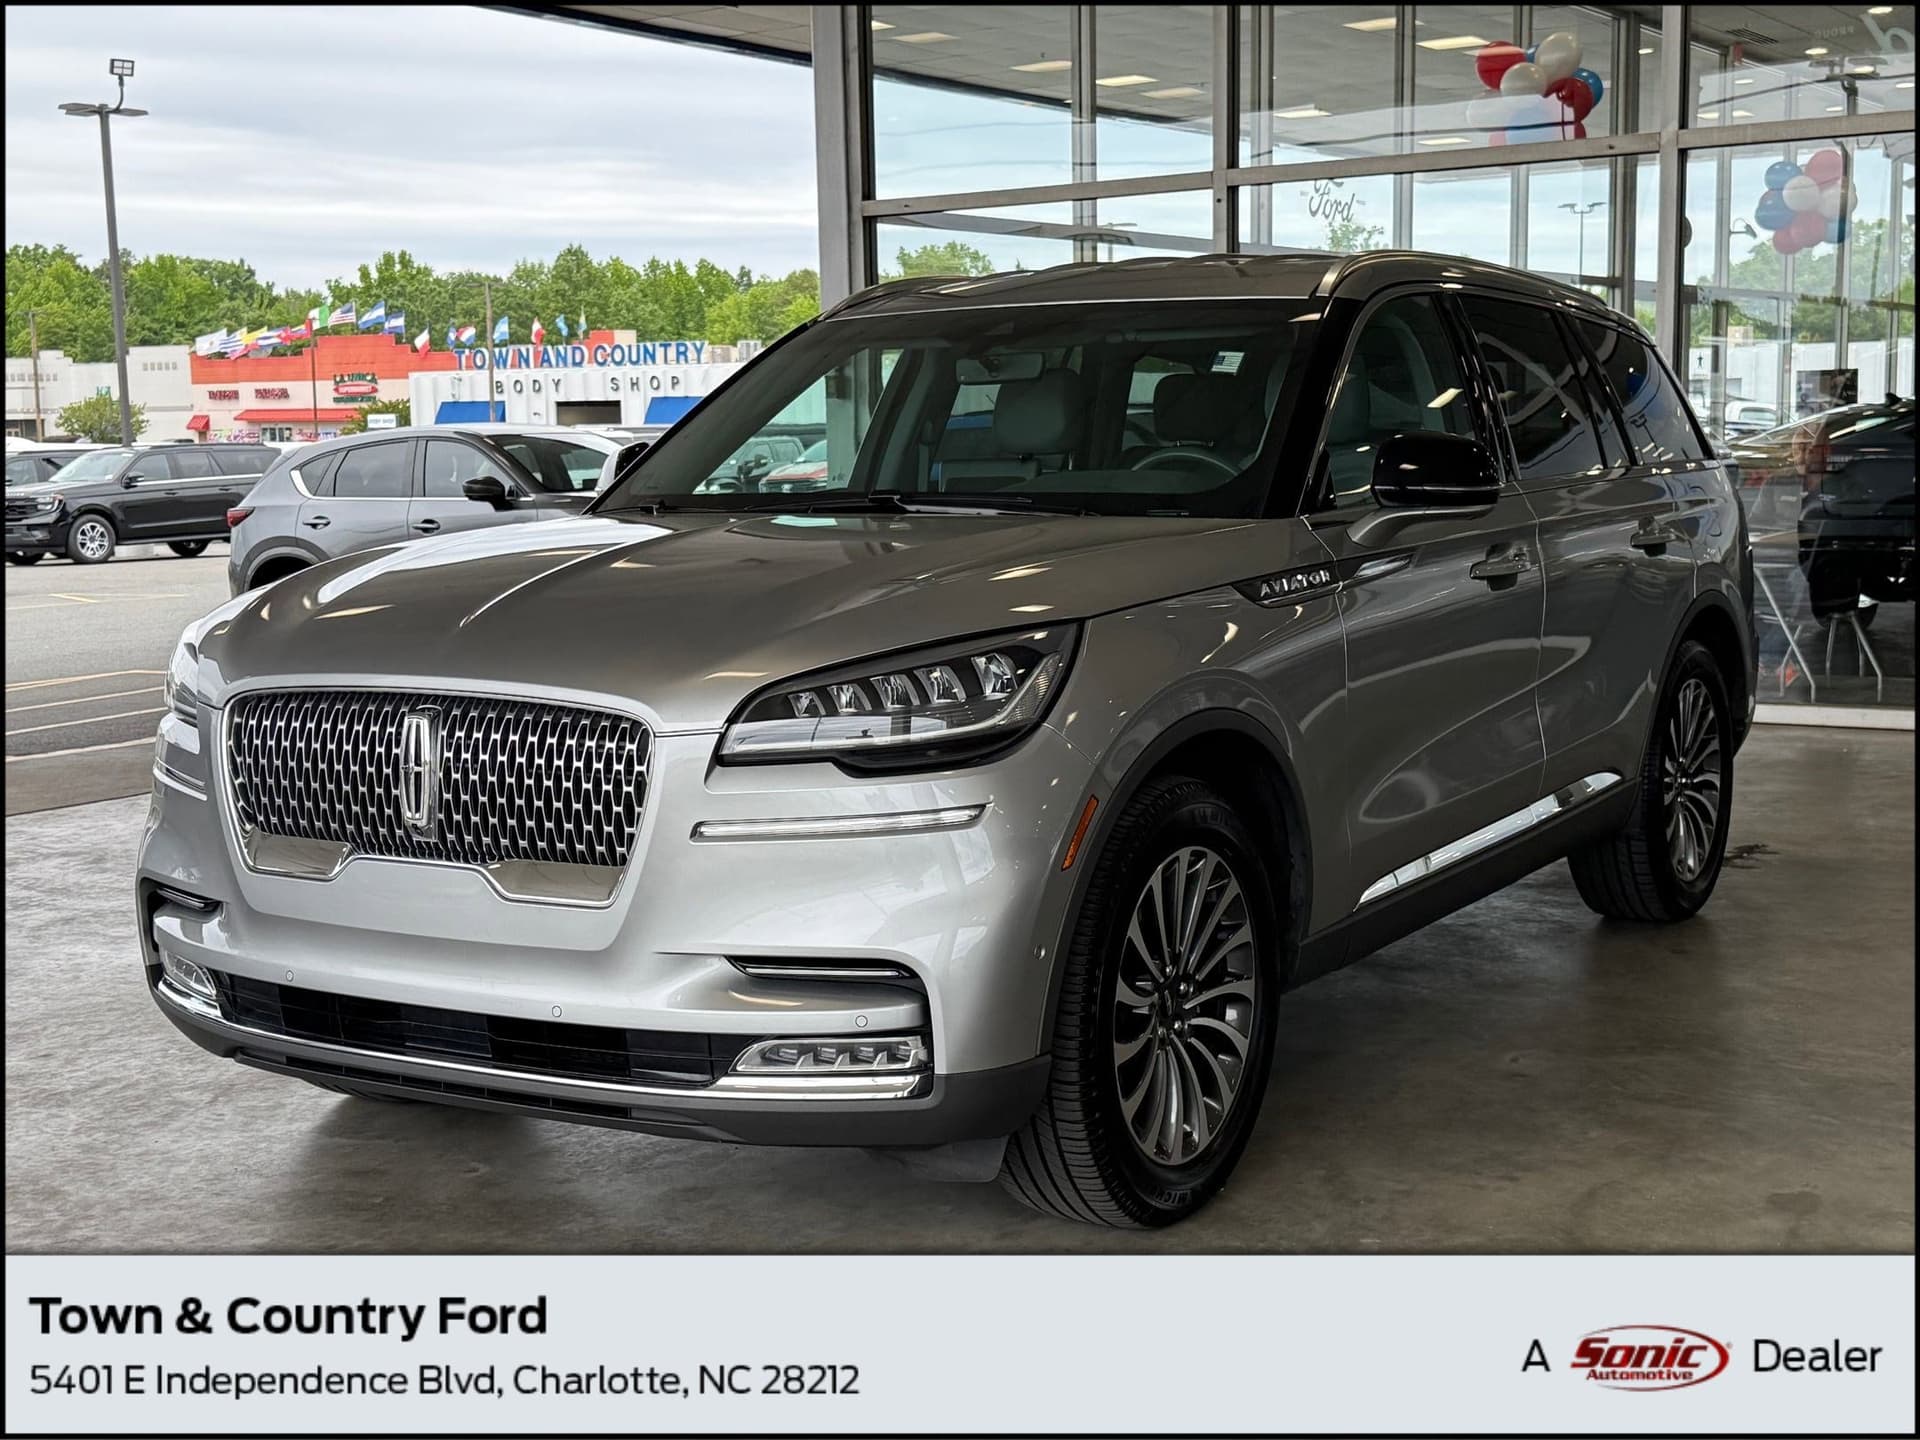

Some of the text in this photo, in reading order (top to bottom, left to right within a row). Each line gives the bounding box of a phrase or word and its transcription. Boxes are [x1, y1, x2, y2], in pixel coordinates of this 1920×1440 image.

[1308, 181, 1356, 223] Ford
[455, 341, 705, 370] TOWN AND COUNTRY
[495, 376, 680, 394] BODY SHOP
[1260, 570, 1331, 597] AVIATOR
